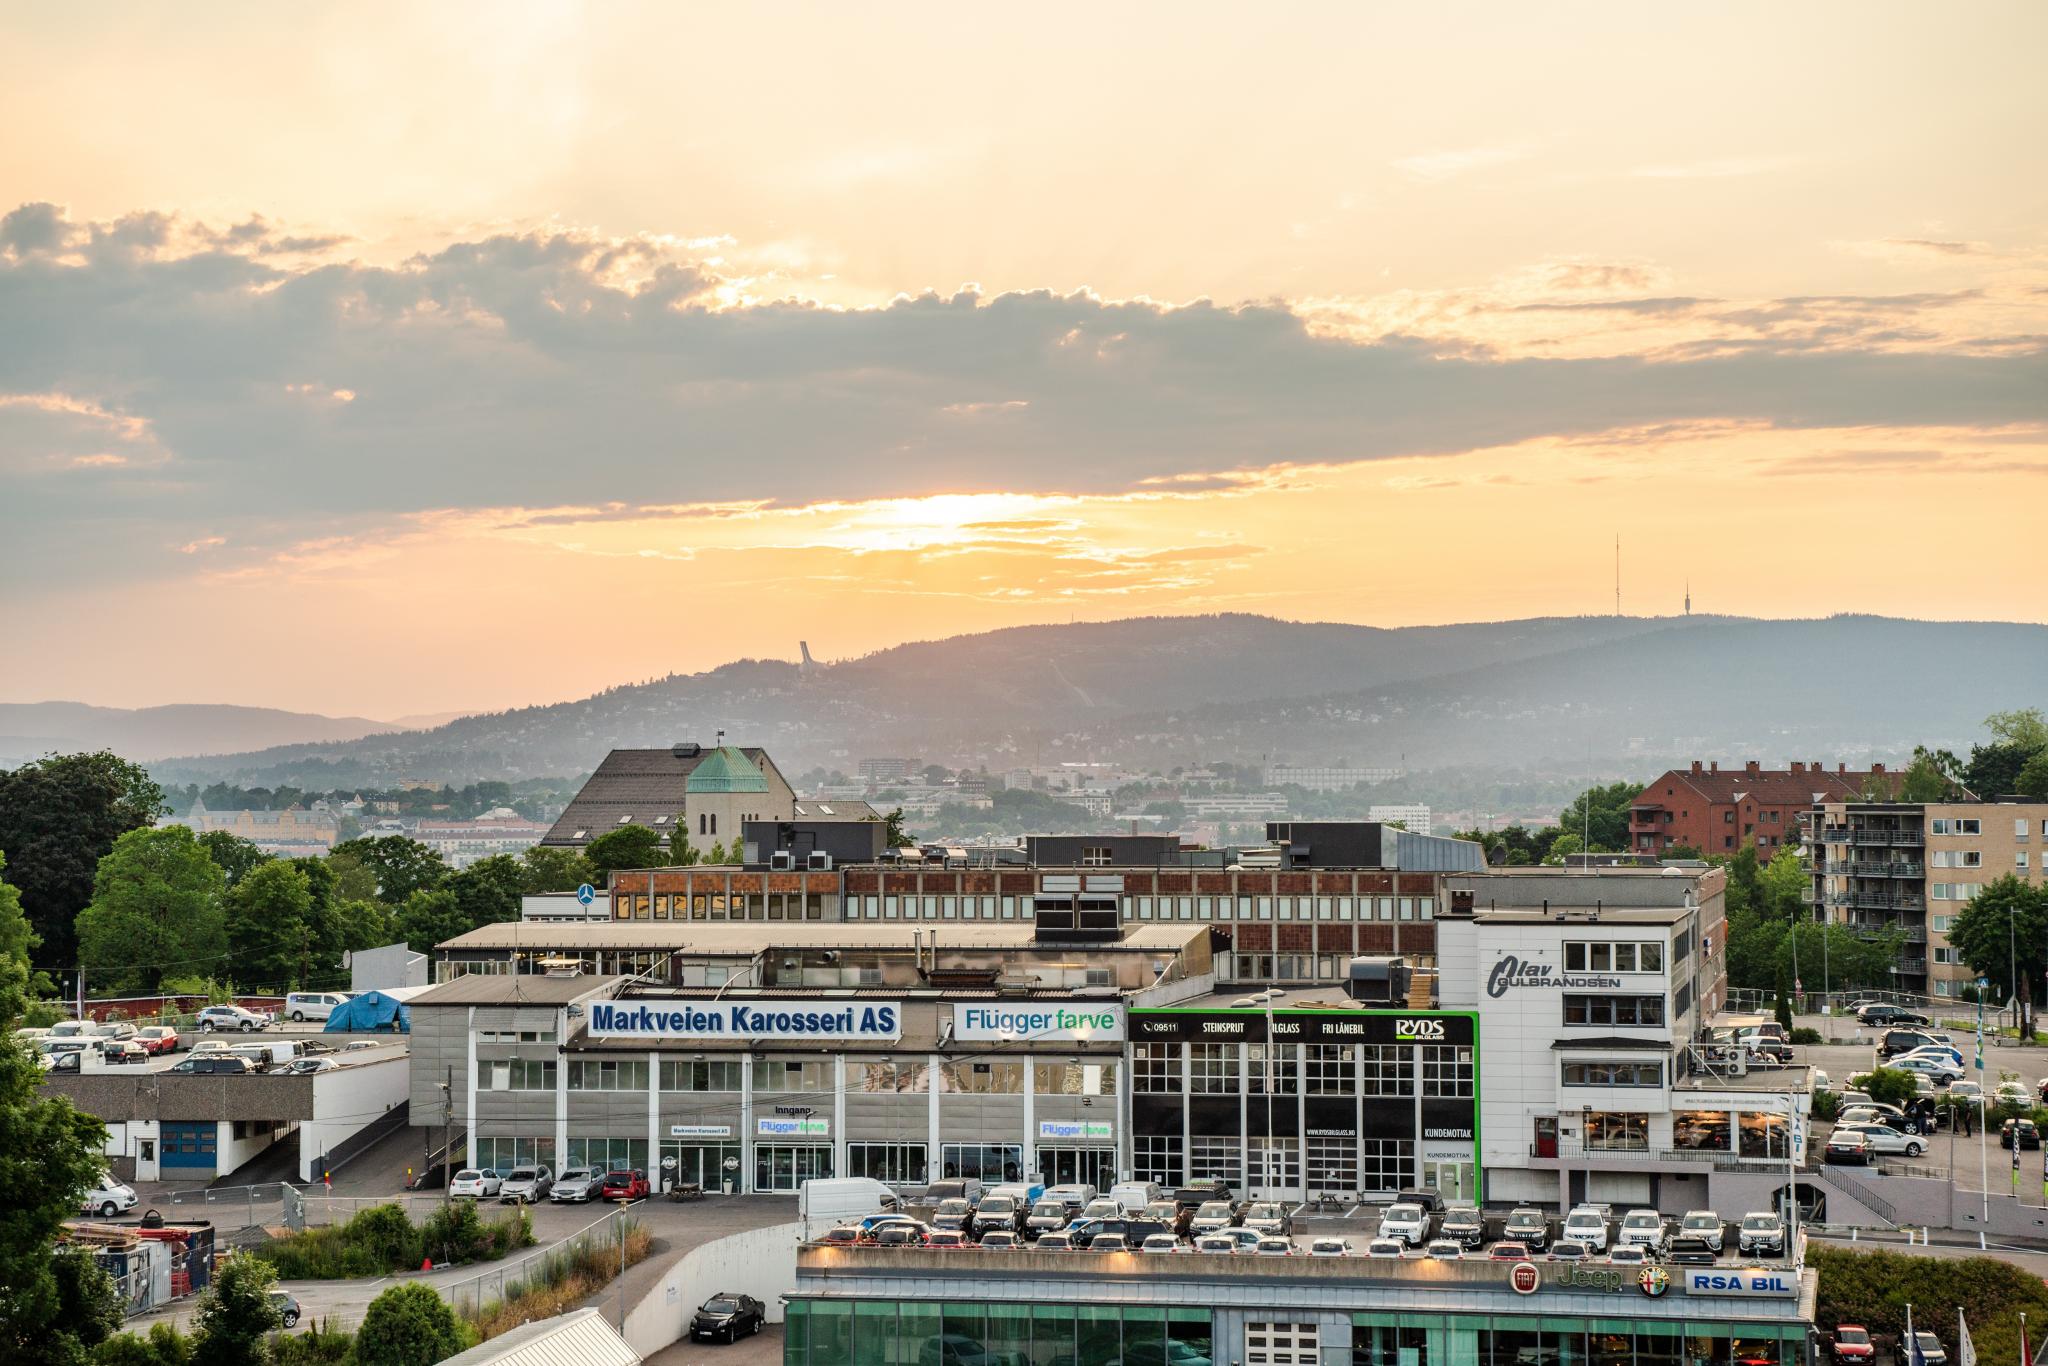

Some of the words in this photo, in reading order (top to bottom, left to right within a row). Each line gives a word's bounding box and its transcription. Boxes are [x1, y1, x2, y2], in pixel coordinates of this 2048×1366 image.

[1487, 955, 1553, 998] Olav
[1497, 977, 1621, 988] GULBRANDSEN
[592, 1005, 722, 1033] Markveien
[731, 1006, 853, 1033] Karosseri
[859, 1006, 896, 1033] AS
[966, 1009, 1052, 1034] Flügger
[1056, 1009, 1115, 1029] farve
[1153, 1023, 1176, 1032] 09511
[1202, 1022, 1244, 1033] STEINSPRUT
[1271, 1023, 1300, 1033] ILGLASS
[1322, 1024, 1333, 1034] FRI
[1335, 1022, 1364, 1034] LÅNEBIL
[1396, 1019, 1445, 1036] RYDS
[775, 1105, 811, 1116] Inngang
[1424, 1128, 1471, 1138] KUNDEMOTTAK
[1516, 1272, 1535, 1286] FIAT
[1558, 1264, 1623, 1293] Jeep
[1694, 1276, 1742, 1290] RSA
[1751, 1277, 1790, 1291] BIL
